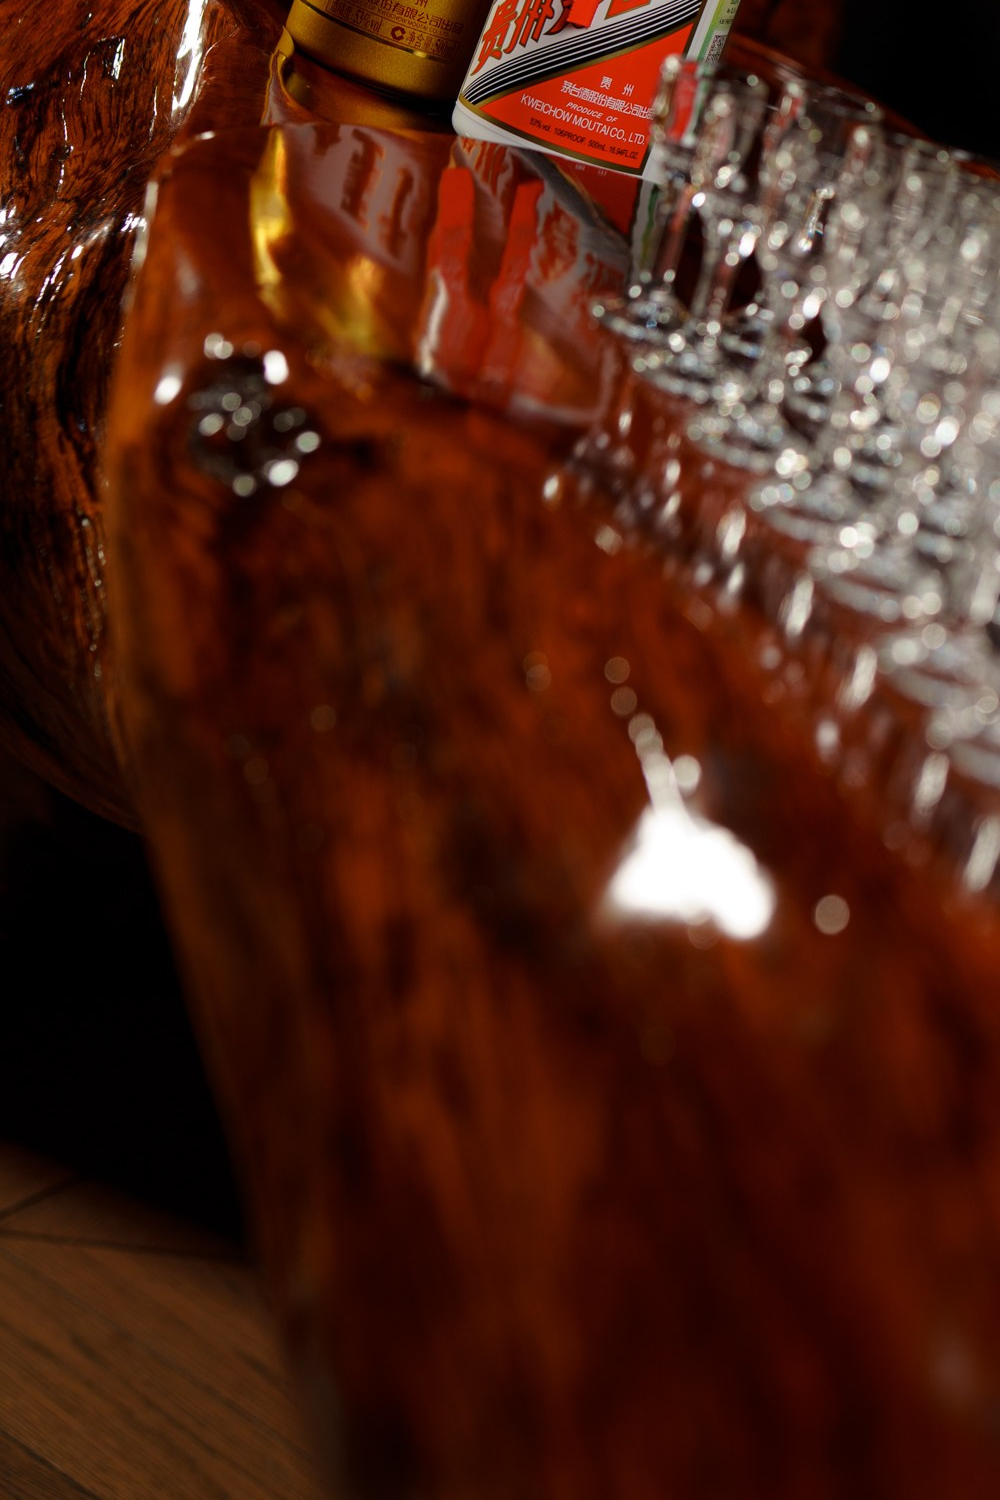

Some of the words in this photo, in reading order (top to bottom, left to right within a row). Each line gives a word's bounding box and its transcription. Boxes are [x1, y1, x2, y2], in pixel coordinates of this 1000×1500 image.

[520, 94, 576, 123] KWEICHOW
[572, 114, 611, 136] MOUTAI
[628, 131, 645, 146] LTD.
[565, 101, 605, 119] PRODUCE
[605, 115, 619, 123] OF
